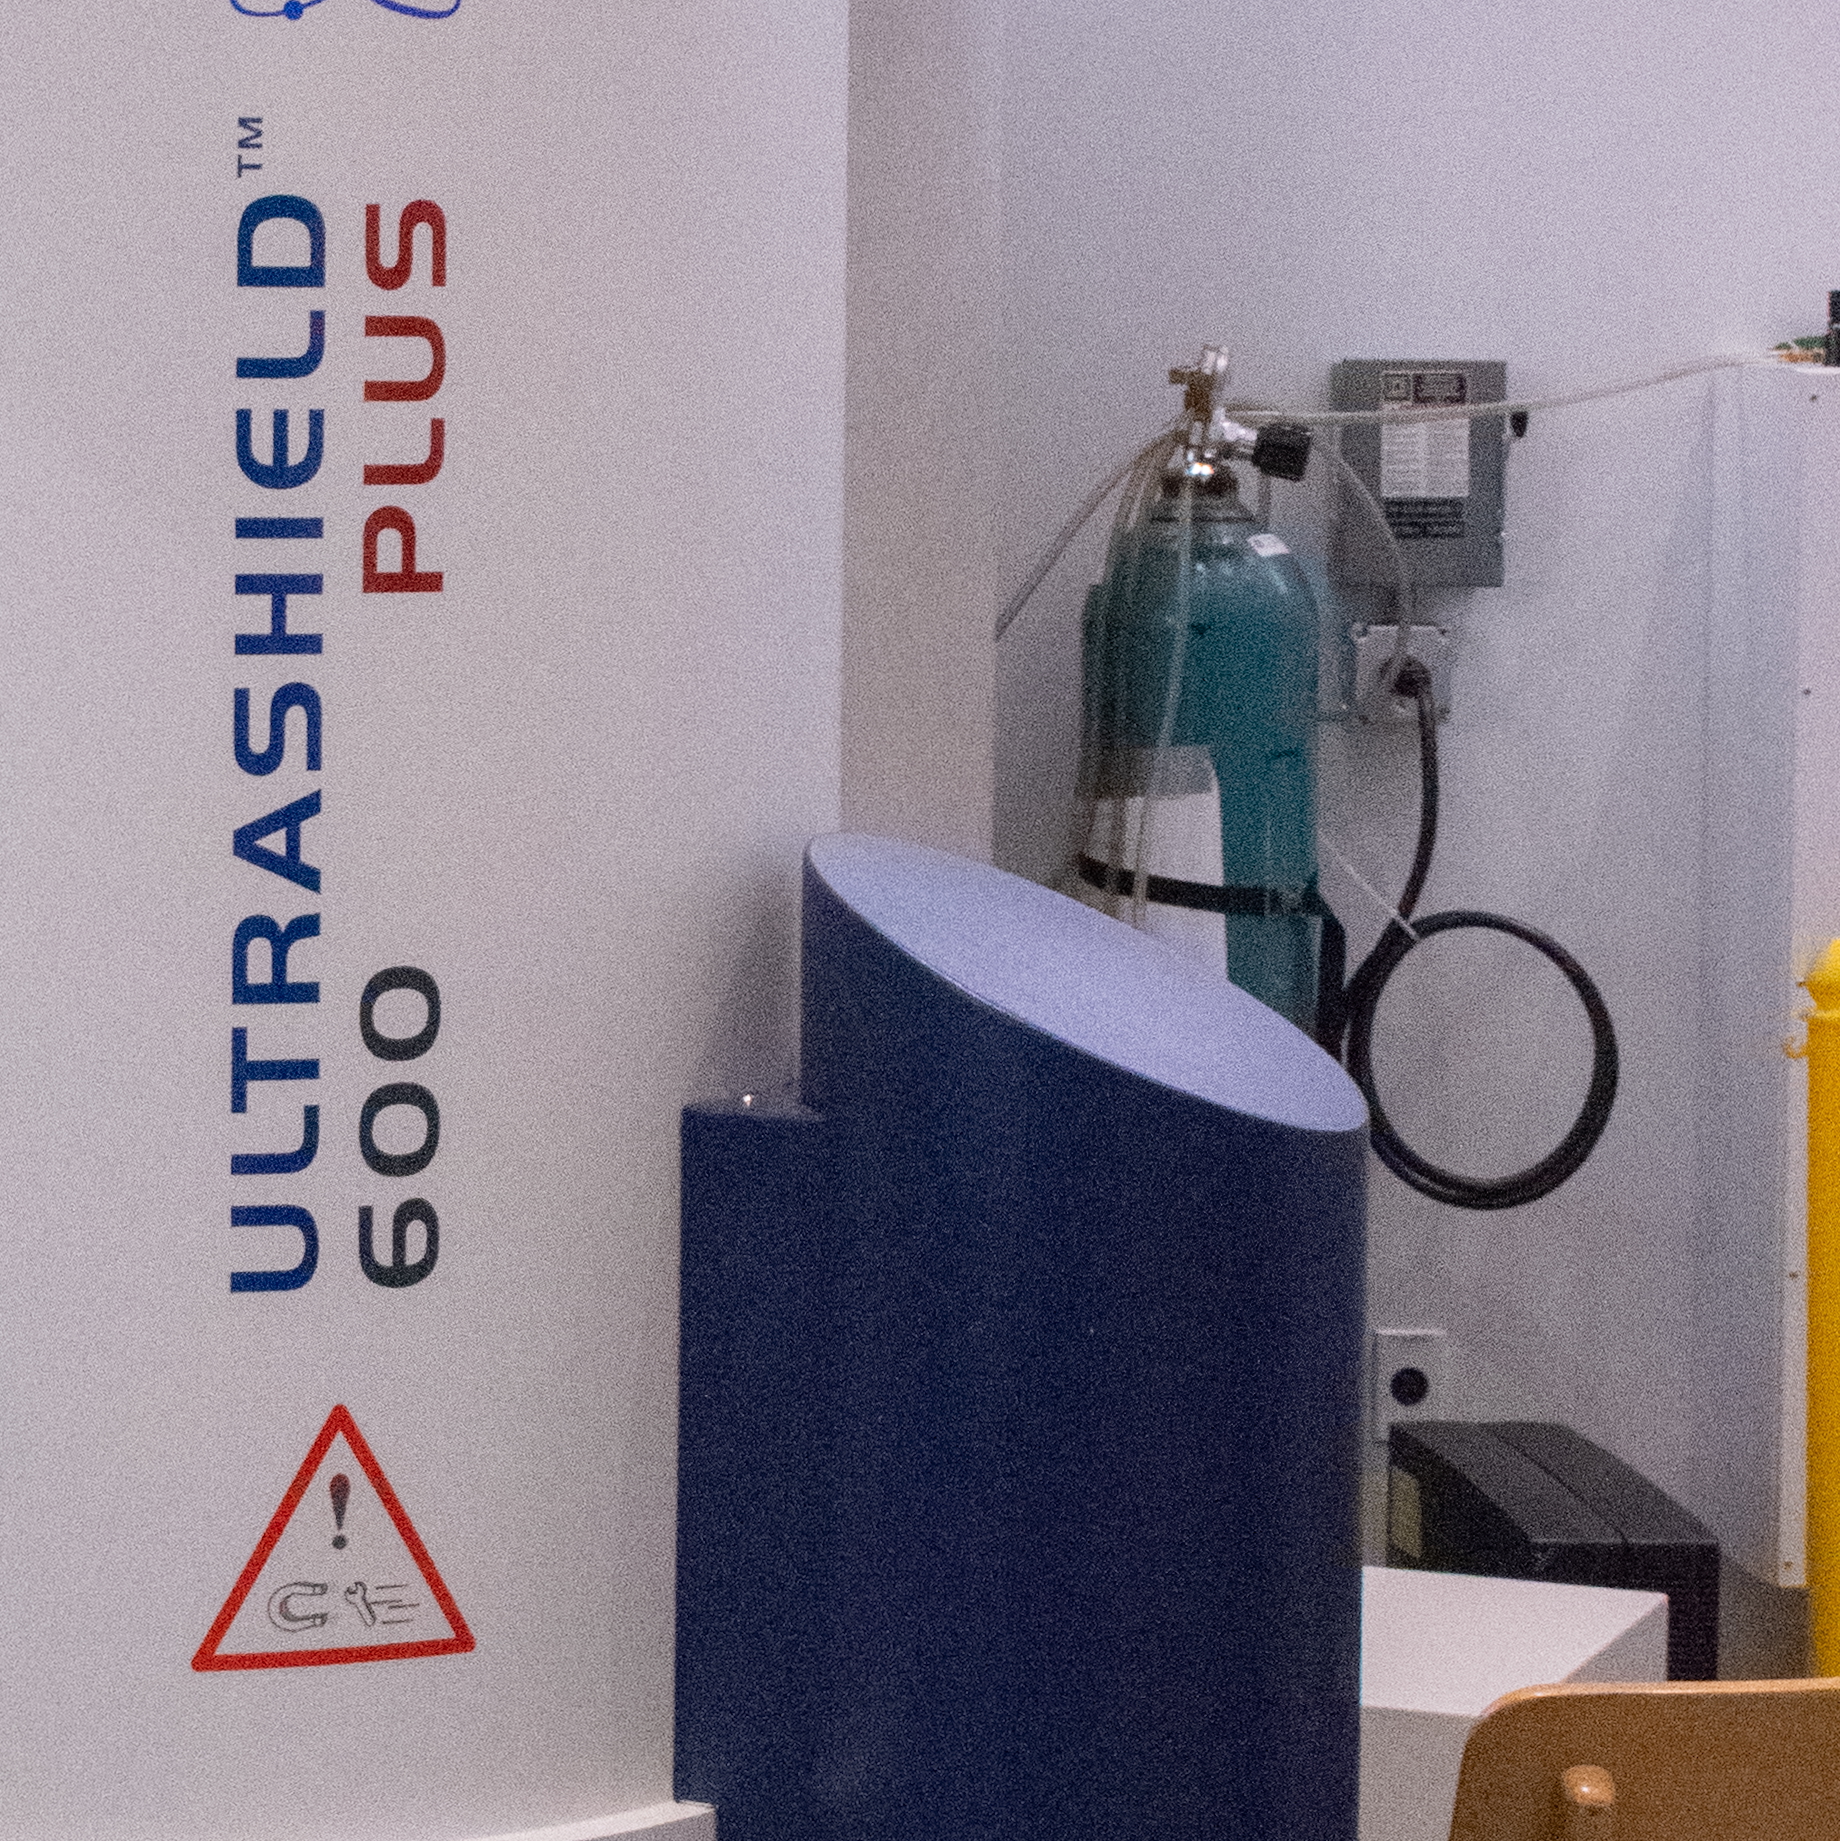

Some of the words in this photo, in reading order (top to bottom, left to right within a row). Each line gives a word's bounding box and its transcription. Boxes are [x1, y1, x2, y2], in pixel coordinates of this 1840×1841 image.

[361, 197, 448, 595] PLUS
[228, 193, 327, 1294] ULTRASHIELD
[357, 965, 442, 1290] 600
